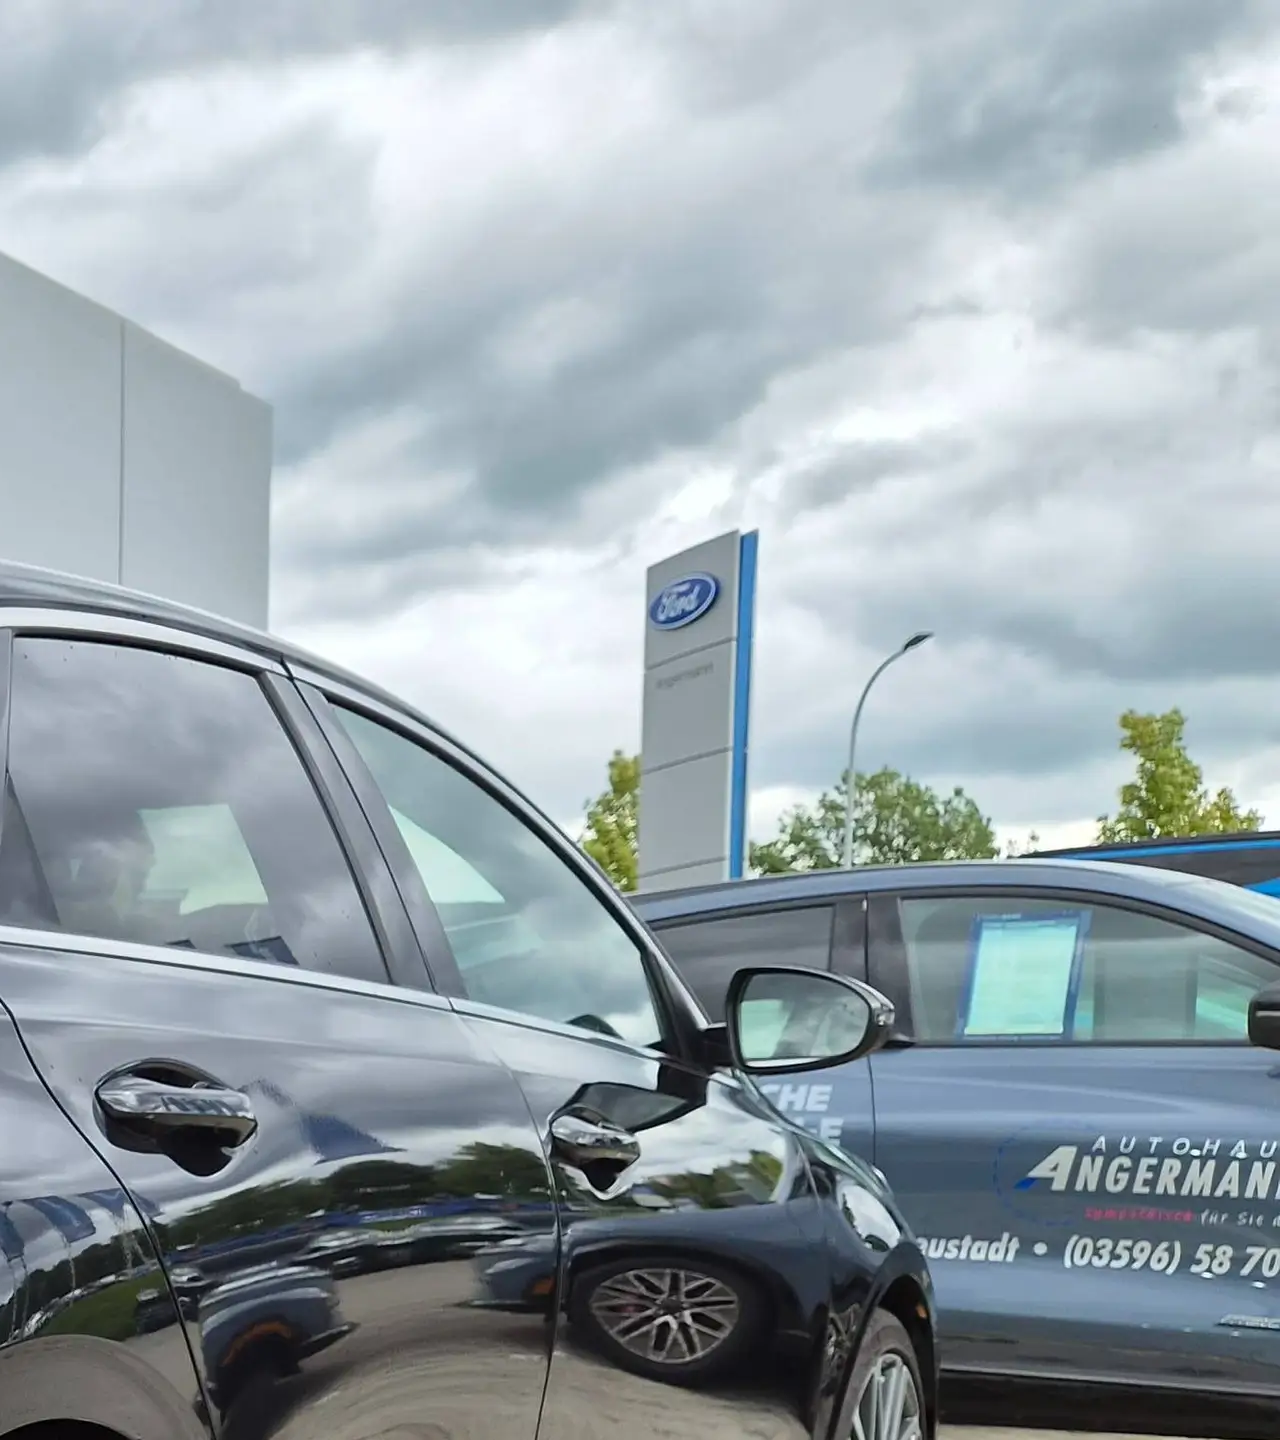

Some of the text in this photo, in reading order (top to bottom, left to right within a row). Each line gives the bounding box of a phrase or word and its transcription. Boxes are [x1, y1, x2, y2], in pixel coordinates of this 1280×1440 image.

[657, 581, 701, 621] Ford
[1014, 1145, 1280, 1201] ANGERMAN
[1063, 1234, 1182, 1275] (03596)
[1190, 1243, 1234, 1275] 58
